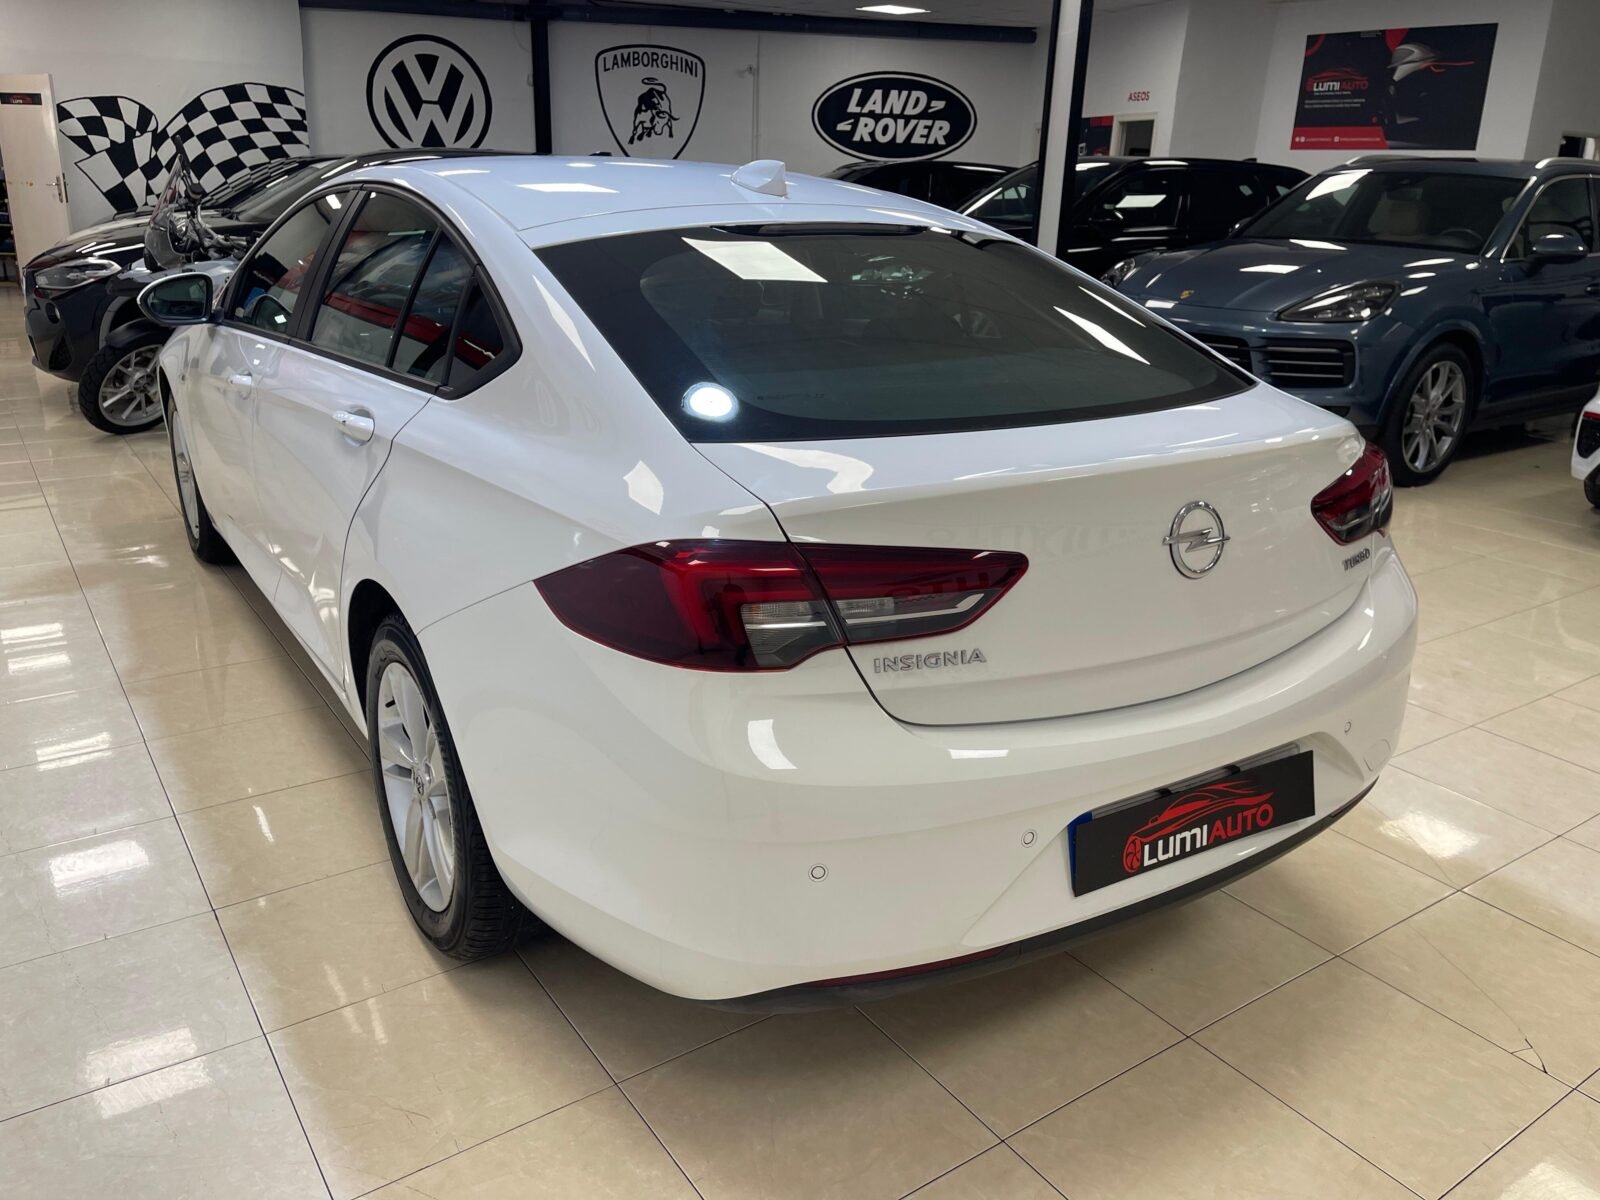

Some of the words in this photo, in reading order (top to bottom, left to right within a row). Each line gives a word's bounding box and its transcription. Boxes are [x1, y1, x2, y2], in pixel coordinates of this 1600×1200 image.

[602, 51, 699, 79] LAMBORGHINI
[846, 88, 931, 115] LAND
[1128, 91, 1150, 102] ASEOS
[852, 117, 951, 146] ROVER
[1342, 548, 1370, 571] TURBO
[873, 648, 987, 673] INSIGNIA
